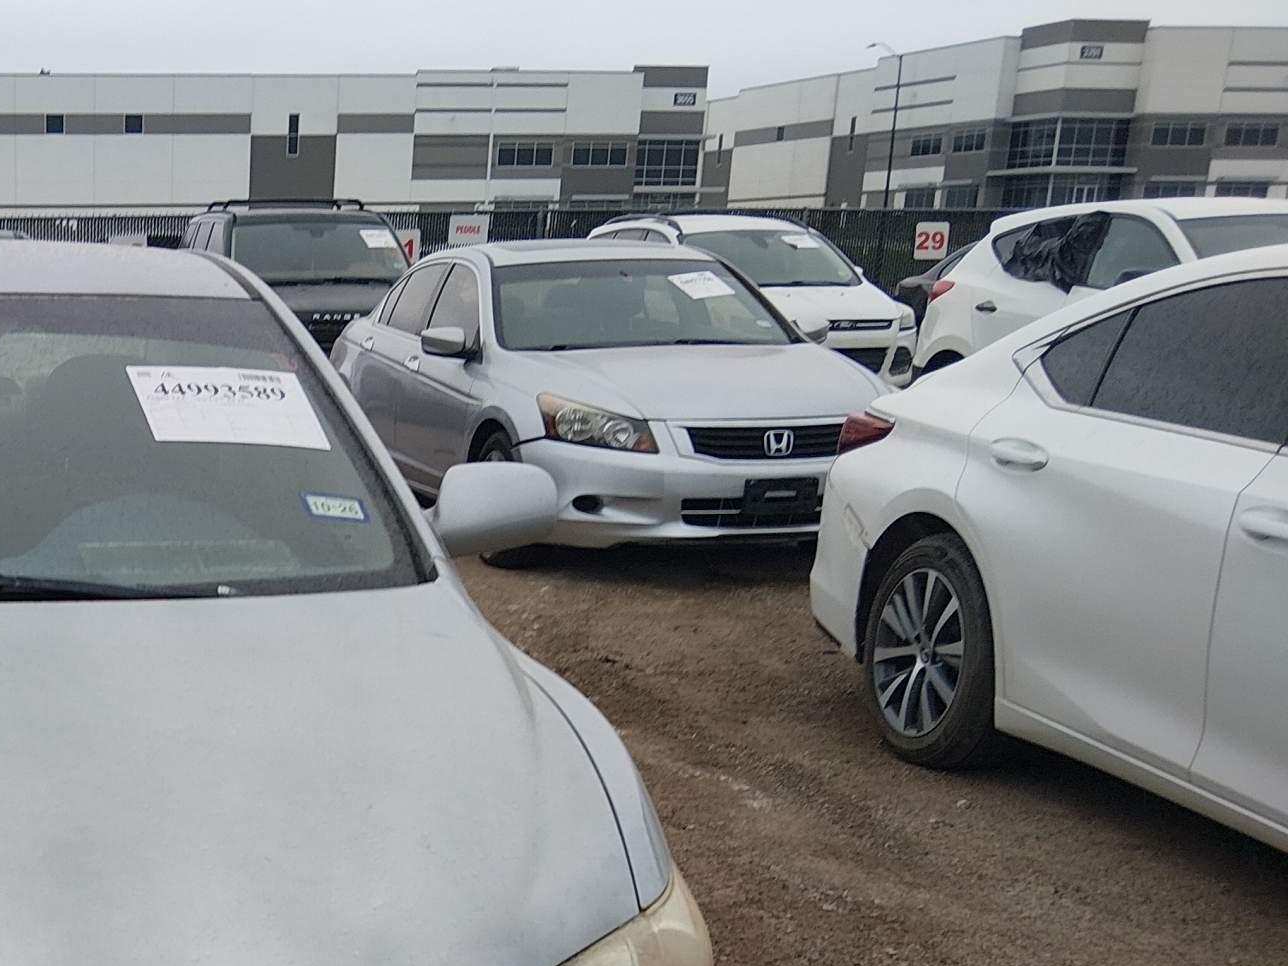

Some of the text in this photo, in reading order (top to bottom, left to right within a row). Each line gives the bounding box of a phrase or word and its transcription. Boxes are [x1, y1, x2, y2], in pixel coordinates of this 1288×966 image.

[916, 231, 945, 250] 29
[312, 313, 361, 321] RANGE
[153, 382, 286, 401] 44993589
